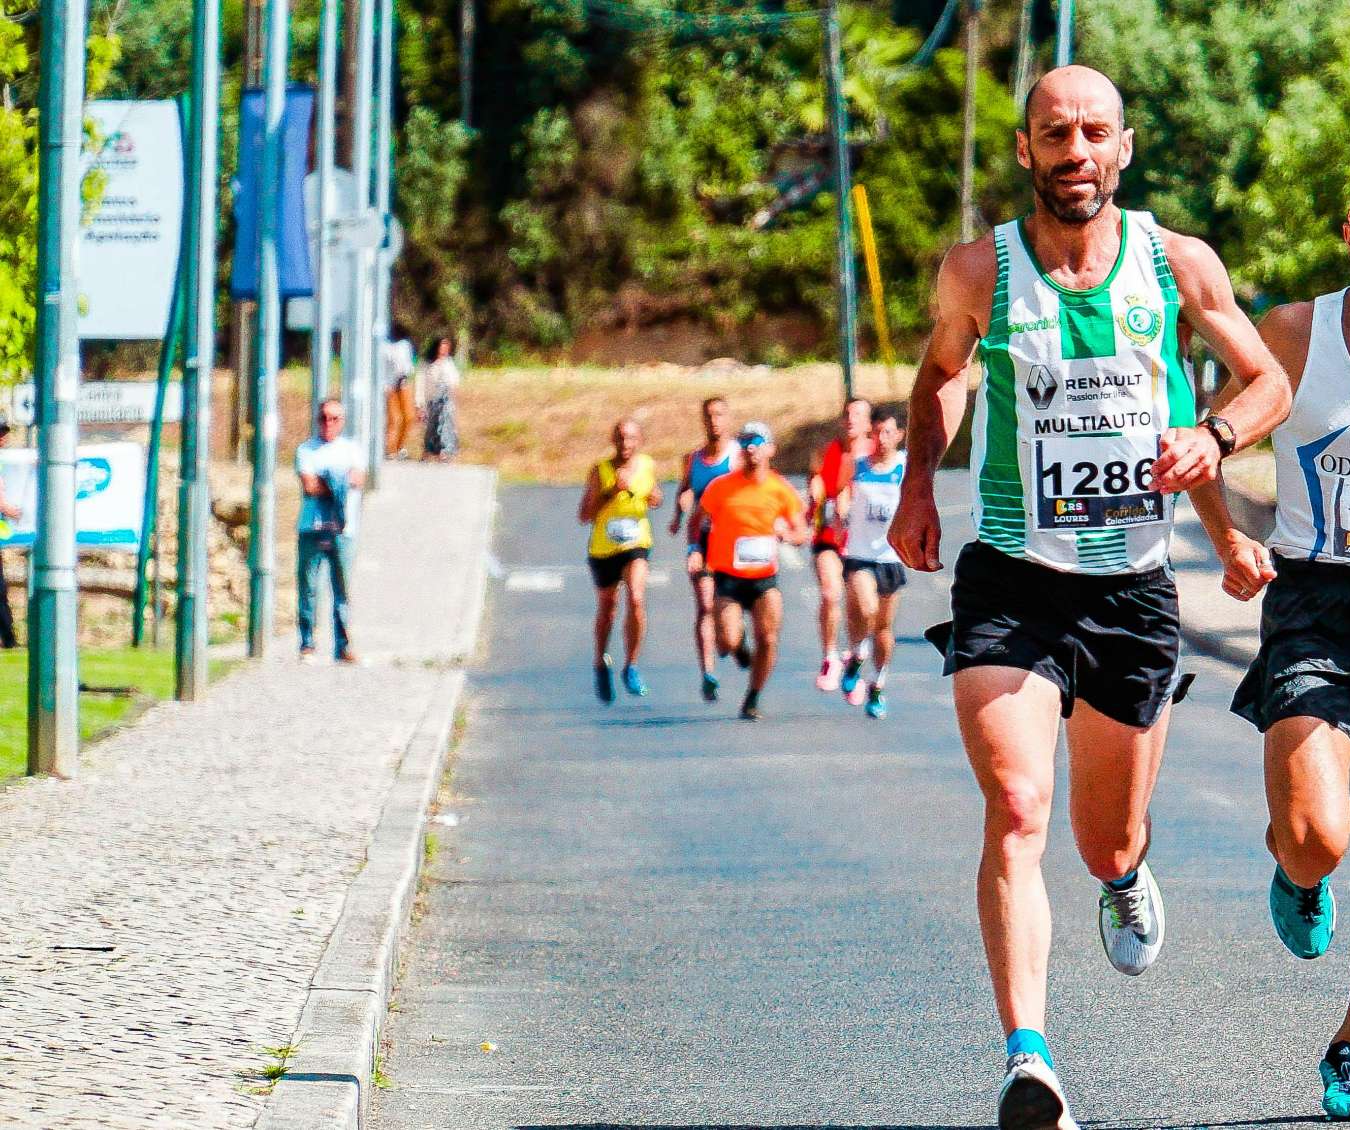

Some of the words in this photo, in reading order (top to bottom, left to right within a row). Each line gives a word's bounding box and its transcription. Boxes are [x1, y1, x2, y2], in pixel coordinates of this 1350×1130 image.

[1065, 374, 1142, 390] RENAULT
[1066, 392, 1099, 402] Passion
[1100, 391, 1111, 400] for
[1034, 411, 1151, 434] MULTIAUTO
[1042, 457, 1157, 496] 1286
[1054, 515, 1090, 523] LOURES
